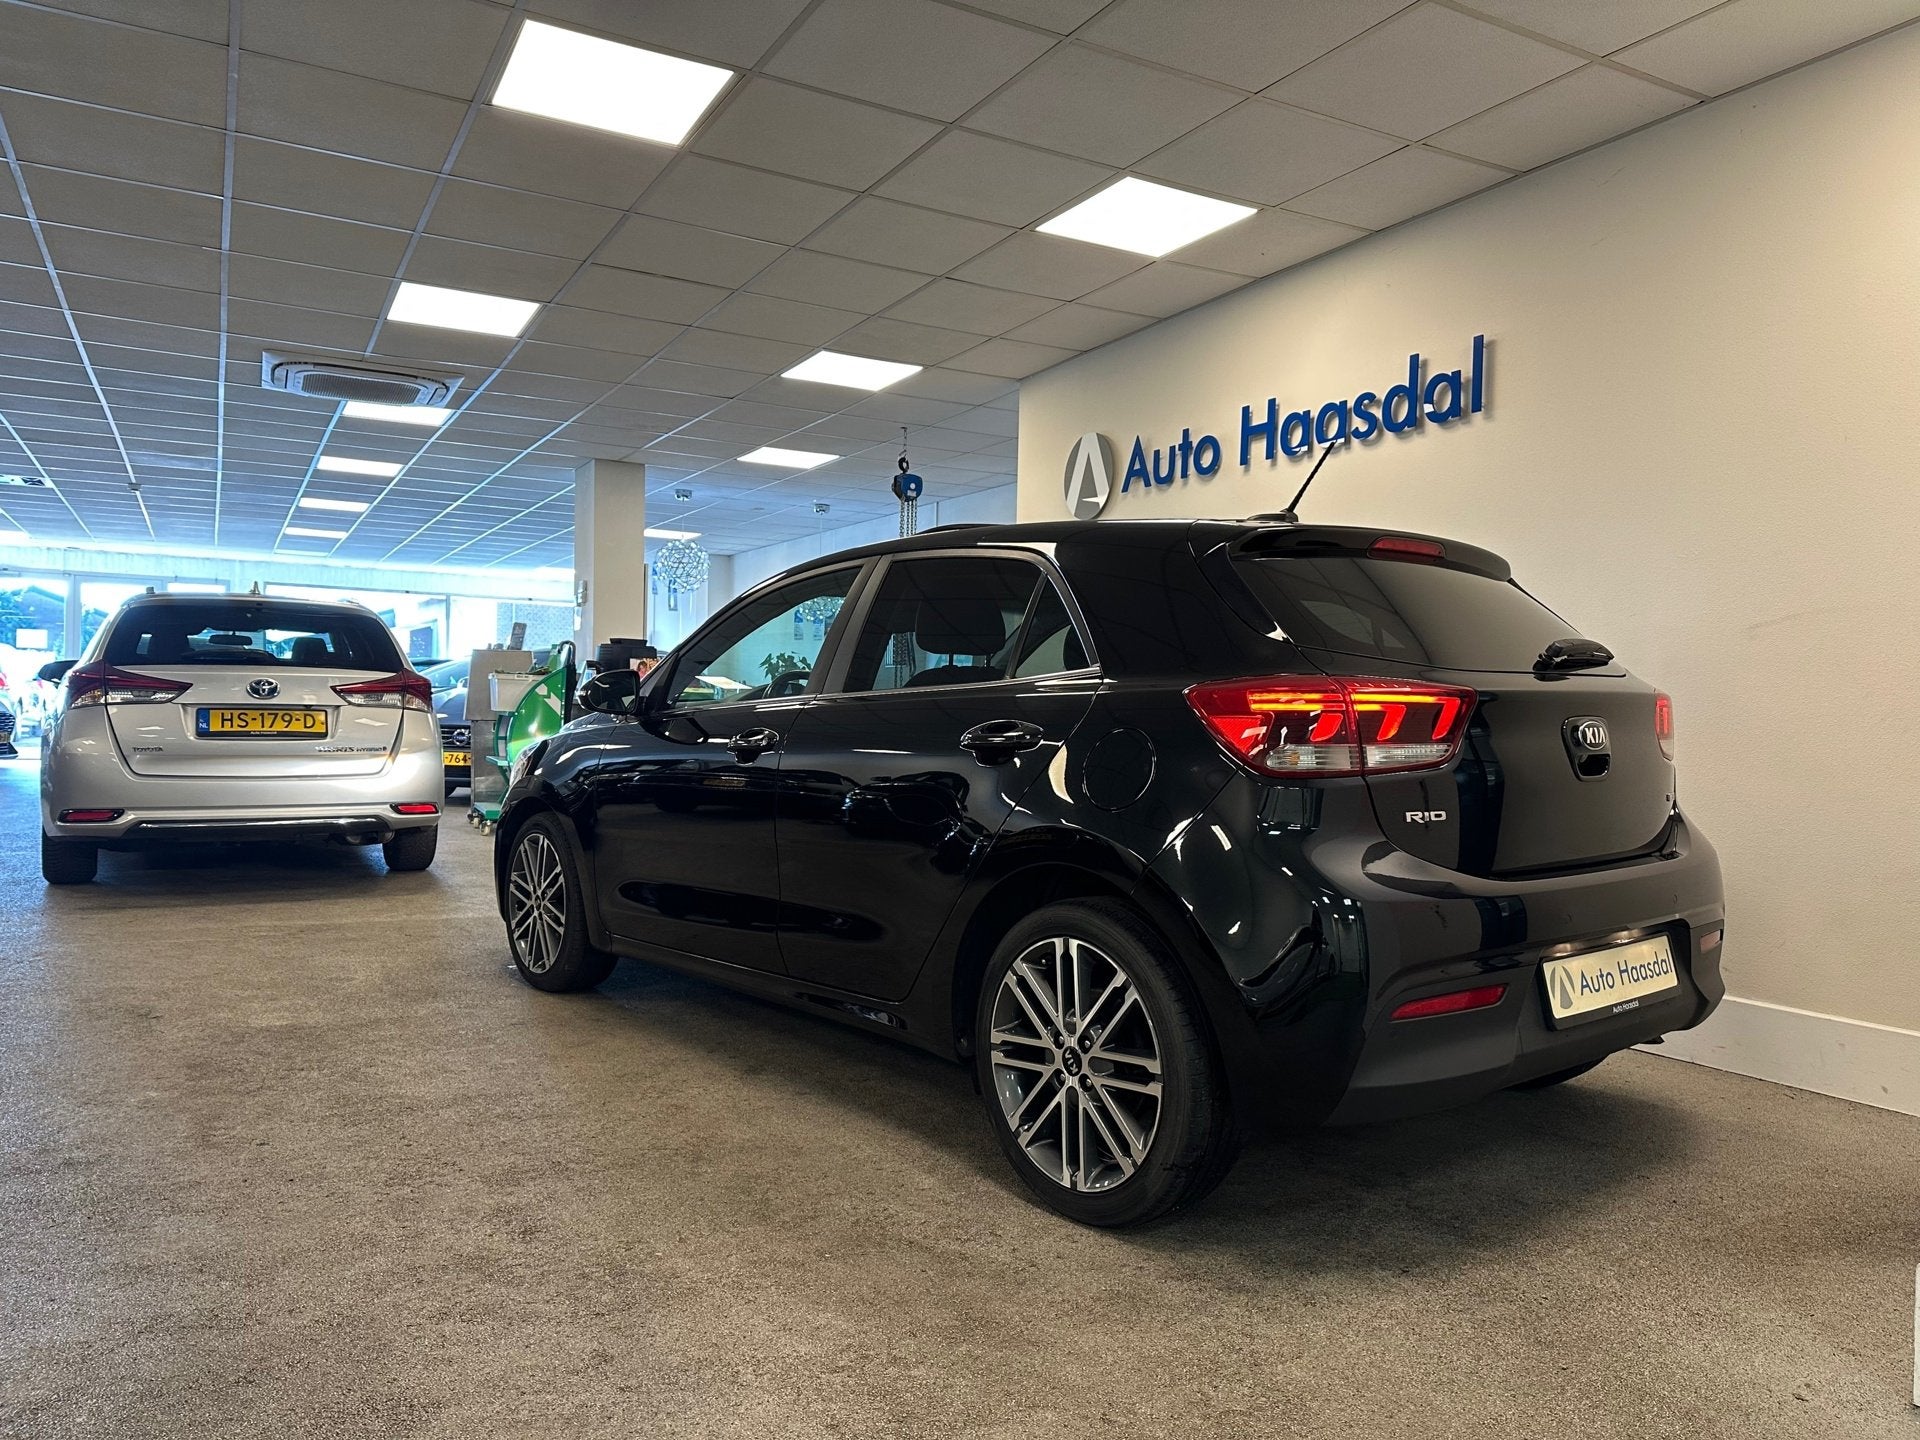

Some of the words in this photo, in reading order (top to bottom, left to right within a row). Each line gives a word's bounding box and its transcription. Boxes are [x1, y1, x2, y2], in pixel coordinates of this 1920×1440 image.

[1121, 428, 1221, 493] Auto
[1239, 334, 1485, 466] Haasdal
[220, 712, 316, 729] HS-179-D
[1585, 727, 1606, 744] KIA
[1405, 810, 1447, 824] RIO
[1580, 968, 1615, 996] Auto
[1617, 948, 1673, 986] Haasdal
[1064, 1050, 1079, 1074] KIA
